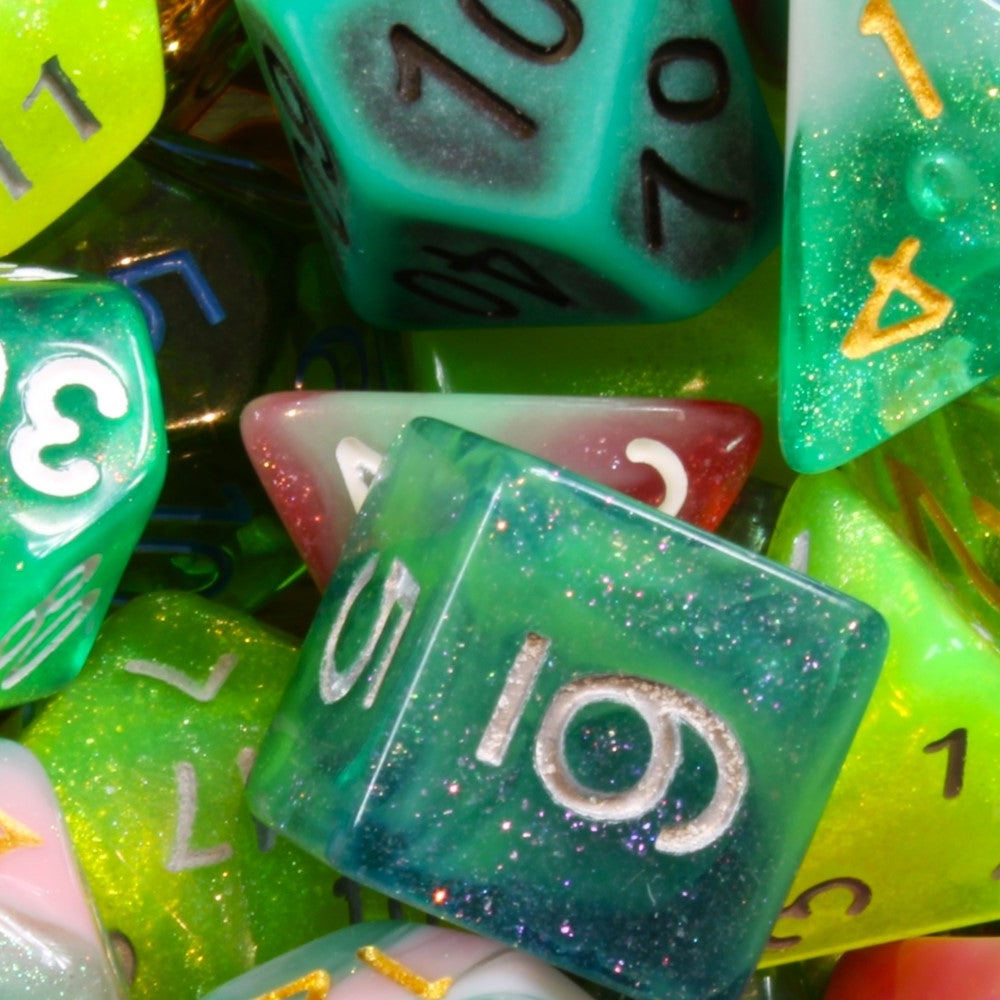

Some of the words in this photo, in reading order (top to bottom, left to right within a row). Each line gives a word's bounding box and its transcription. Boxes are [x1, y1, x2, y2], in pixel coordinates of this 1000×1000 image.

[388, 0, 584, 140] 10
[859, 0, 944, 119] 1
[637, 37, 752, 256] 70
[841, 237, 954, 359] 4
[923, 728, 968, 799] 1
